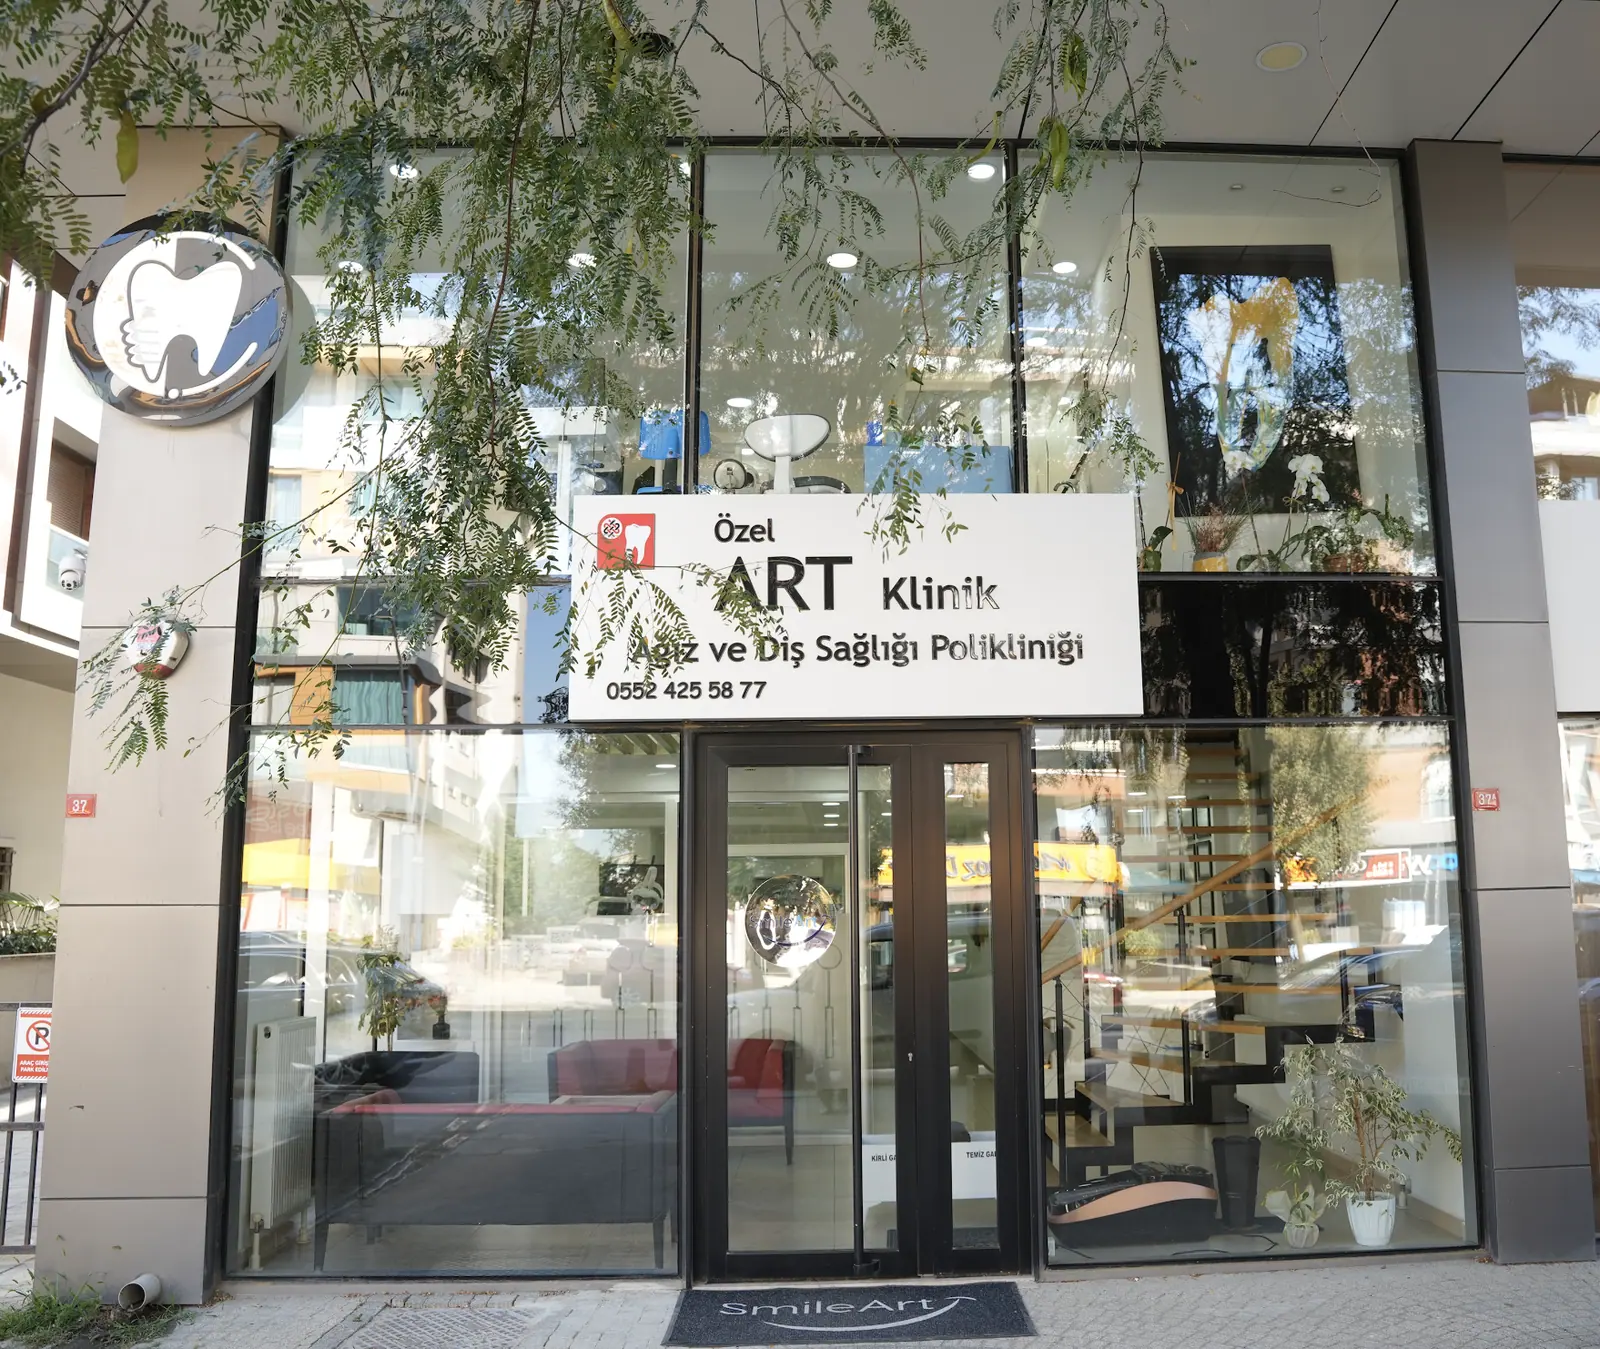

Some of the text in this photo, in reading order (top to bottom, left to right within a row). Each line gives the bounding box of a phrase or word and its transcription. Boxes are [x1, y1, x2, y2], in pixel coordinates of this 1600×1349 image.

[714, 512, 775, 543] Özel
[713, 555, 1000, 612] ART Klinik
[708, 642, 747, 662] ve
[759, 634, 805, 668] Diş
[815, 632, 918, 668] Sağlığı
[931, 631, 1084, 666] Polikliniği
[606, 681, 767, 700] 0552 425 58 77
[72, 799, 88, 813] 37
[871, 1153, 888, 1161] KİRLİ
[719, 1299, 934, 1316] SmileArt
